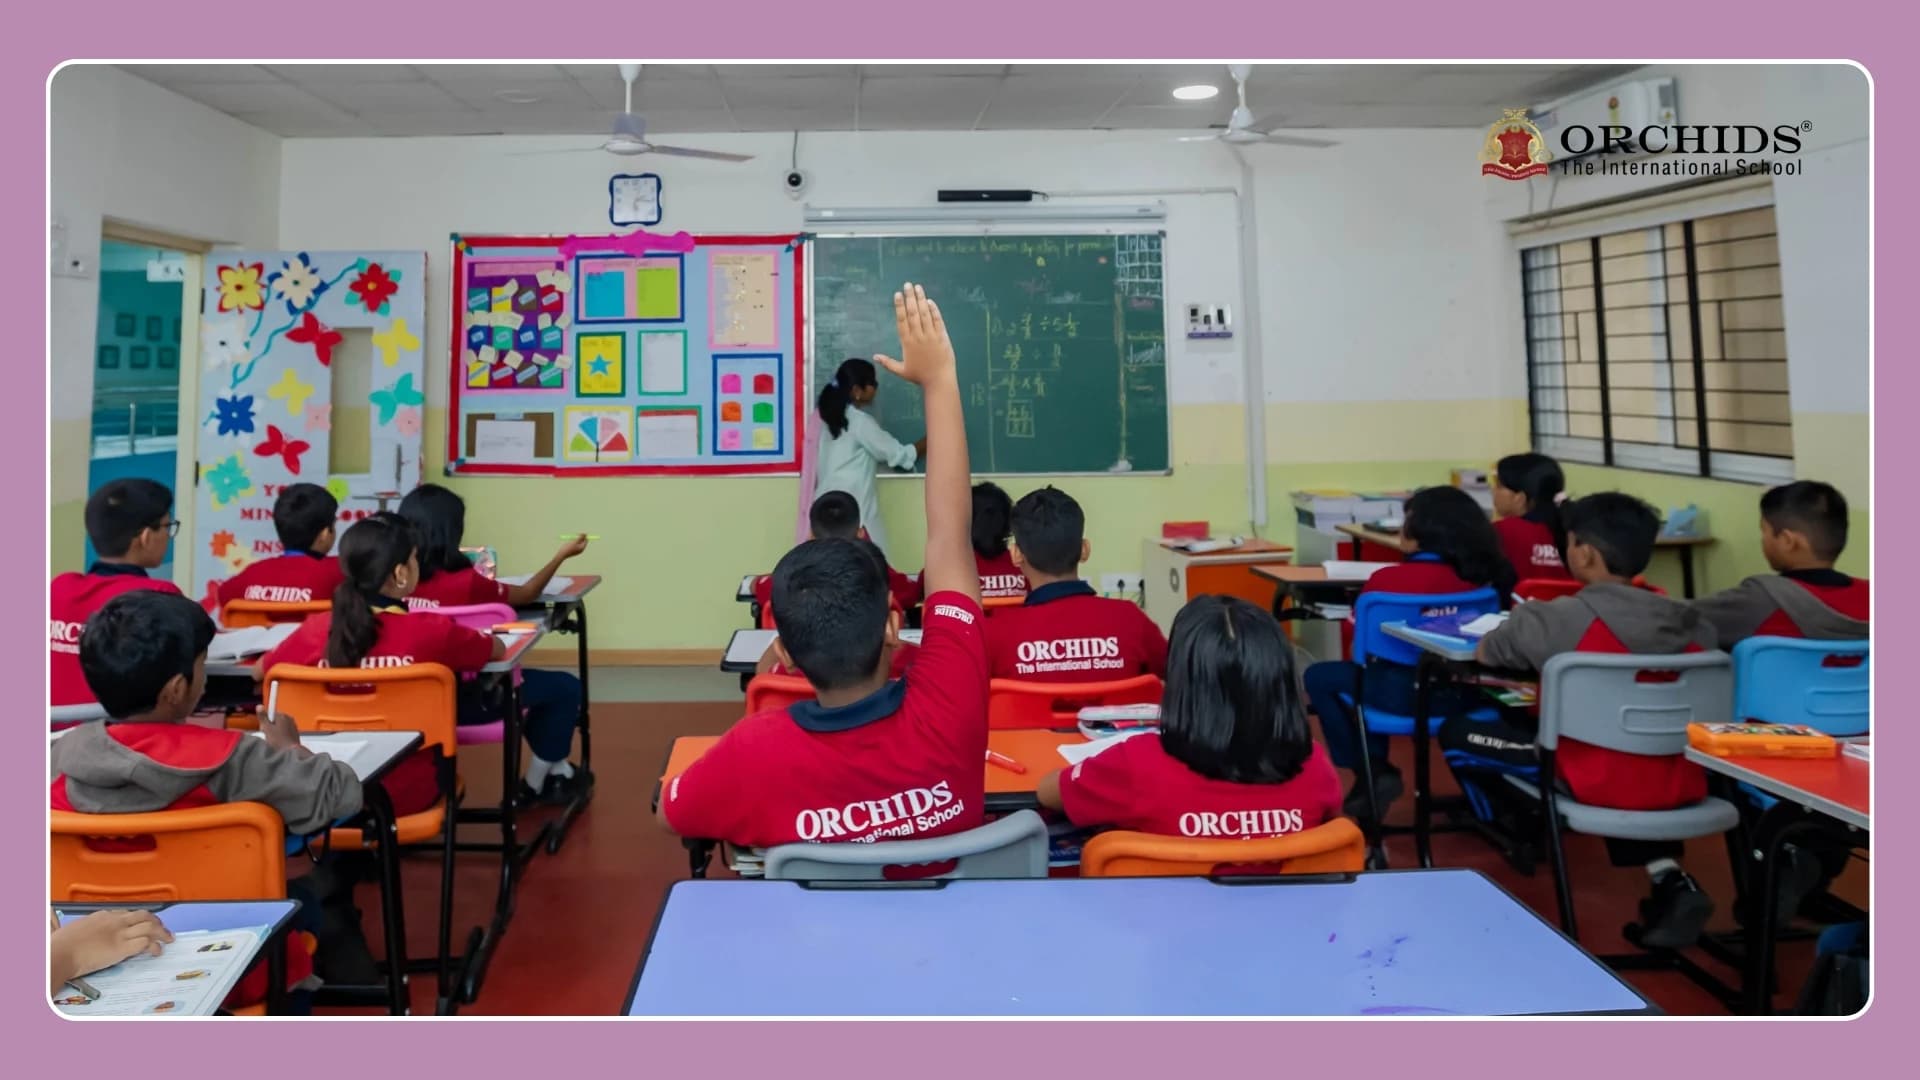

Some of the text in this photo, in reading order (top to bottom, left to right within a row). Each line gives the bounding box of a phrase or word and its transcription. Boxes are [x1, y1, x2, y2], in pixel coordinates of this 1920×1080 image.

[264, 484, 288, 497] YO
[240, 507, 275, 521] MIN
[254, 539, 286, 553] INS
[979, 574, 1026, 589] CHIDS
[1017, 637, 1120, 662] ORCHIDS
[1016, 658, 1125, 674] The International School
[795, 780, 953, 841] ORCHIDS
[916, 800, 965, 832] School
[1179, 808, 1304, 837] ORCHIDS
